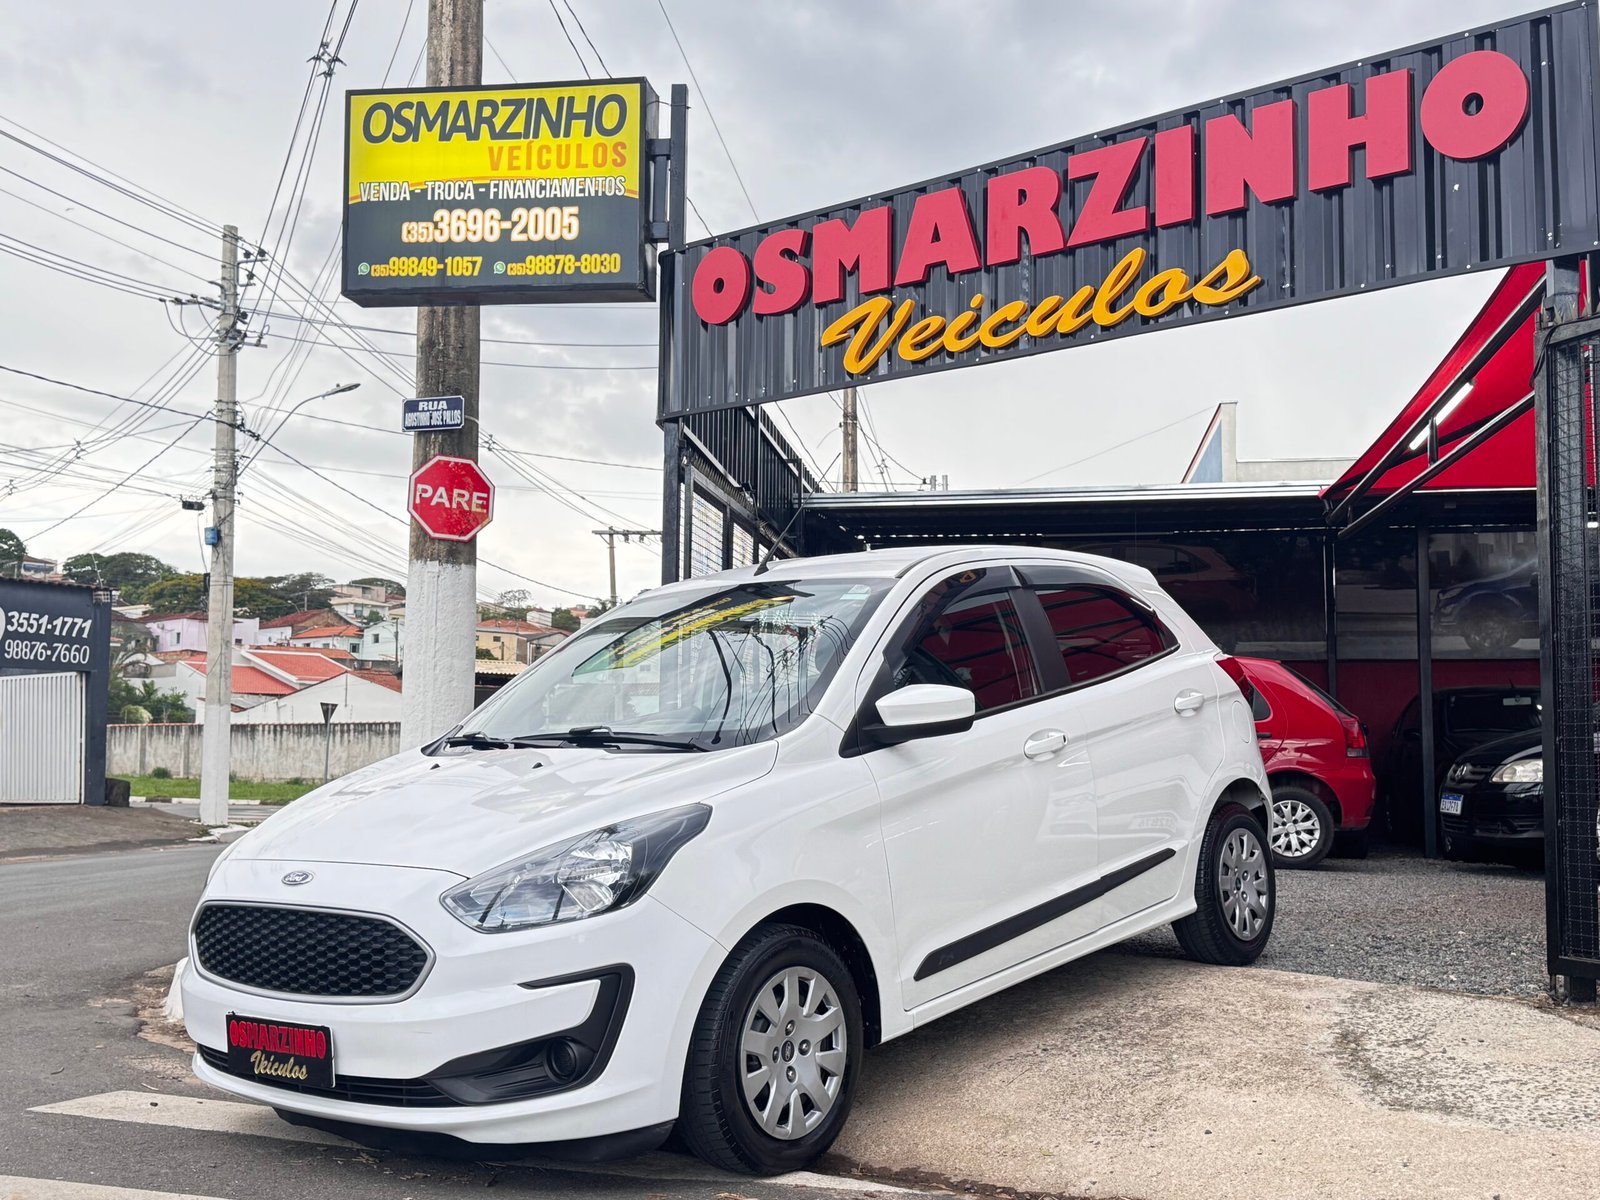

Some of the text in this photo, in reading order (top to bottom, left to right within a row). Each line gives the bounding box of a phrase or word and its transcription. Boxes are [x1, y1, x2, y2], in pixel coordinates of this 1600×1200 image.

[362, 93, 628, 144] OSMARZINHO
[488, 140, 628, 172] VEÍCULOS
[359, 181, 411, 202] VENDA
[425, 180, 475, 201] TROCA
[489, 176, 626, 200] FINANCIAMENTOS
[691, 50, 1530, 326] OSMARZINHO
[820, 246, 1262, 375] Veiculos
[418, 400, 448, 411] RUA
[415, 483, 488, 514] PARE
[229, 1019, 327, 1060] OSMARZINHO
